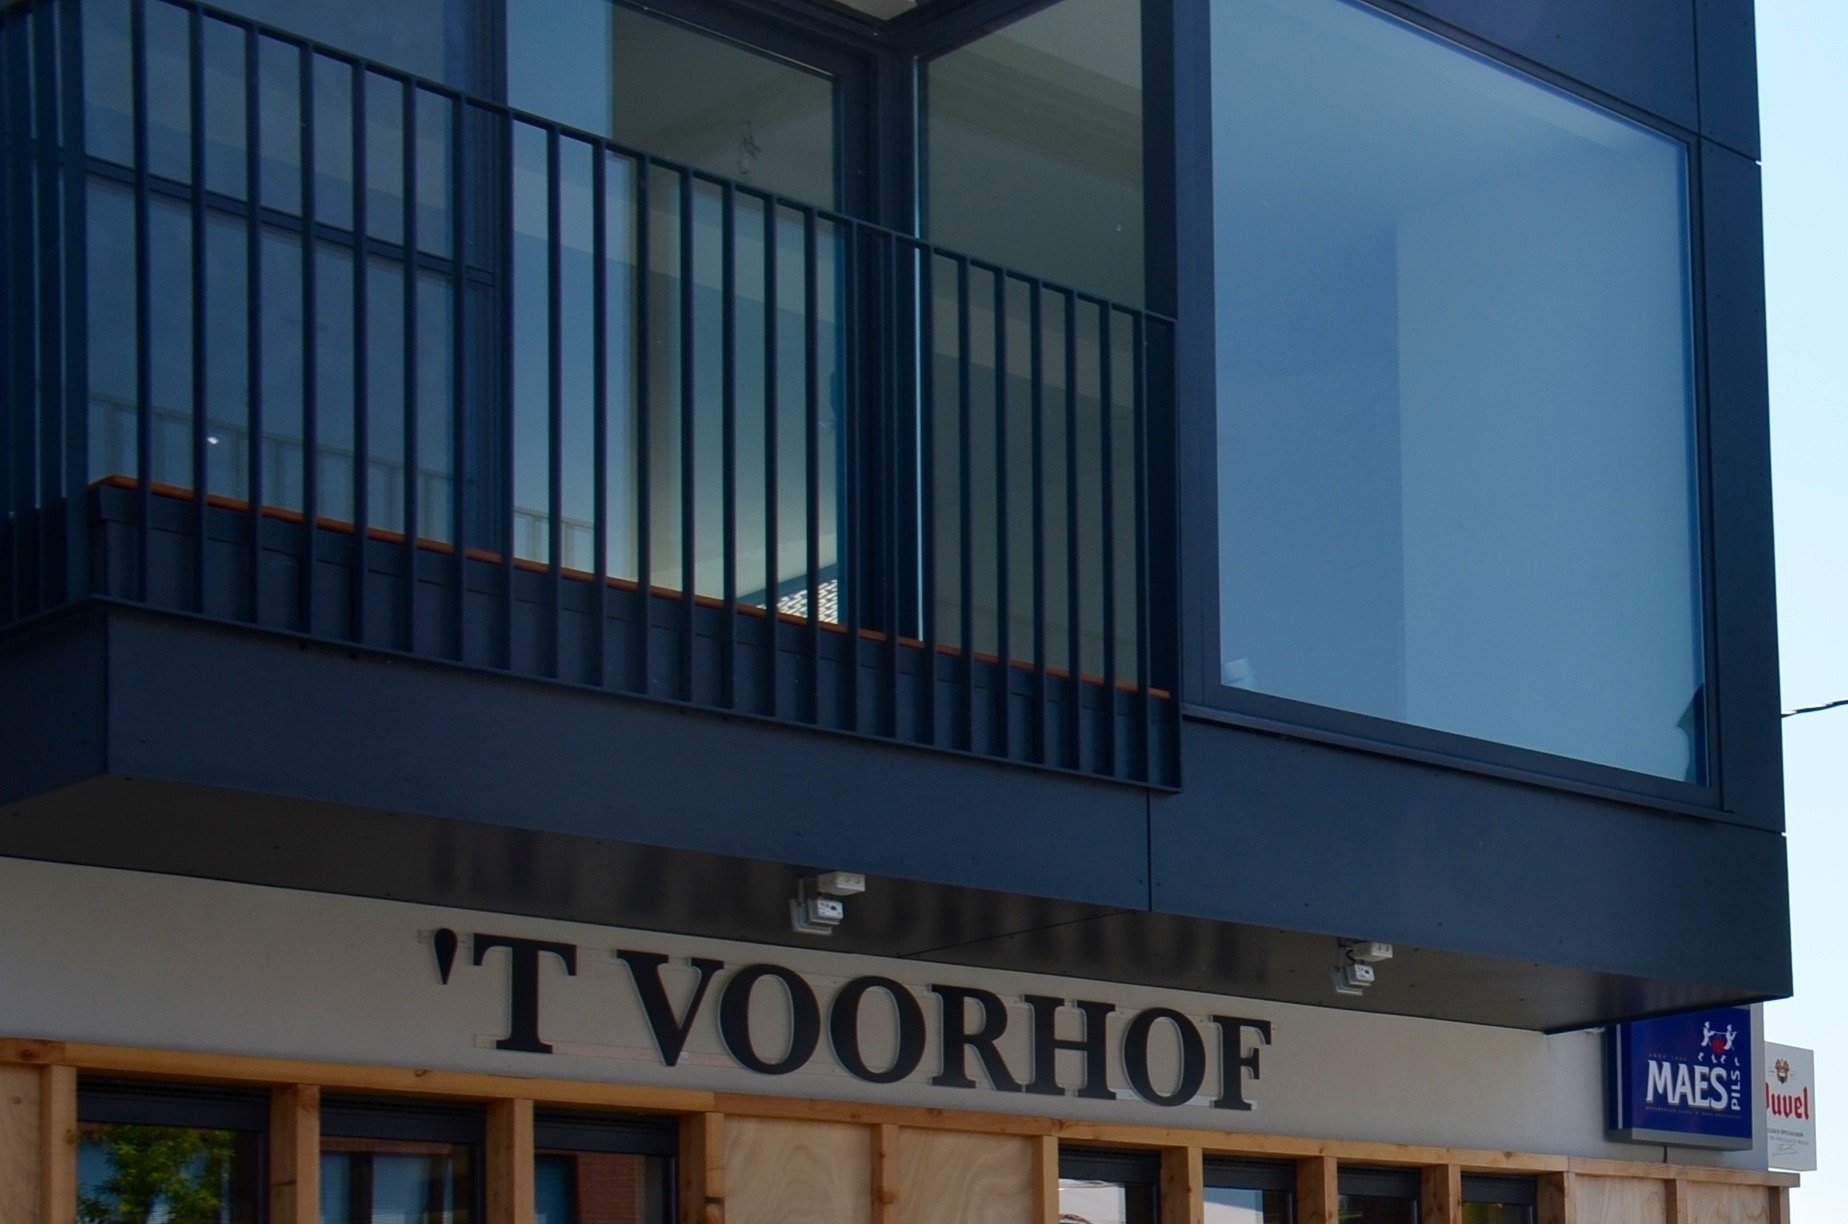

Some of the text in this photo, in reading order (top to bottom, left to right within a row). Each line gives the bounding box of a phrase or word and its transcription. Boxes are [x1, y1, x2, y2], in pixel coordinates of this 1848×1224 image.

[431, 926, 1273, 1111] 'T VOORHOF
[1645, 1059, 1730, 1111] MAES
[1730, 1069, 1741, 1112] PILS
